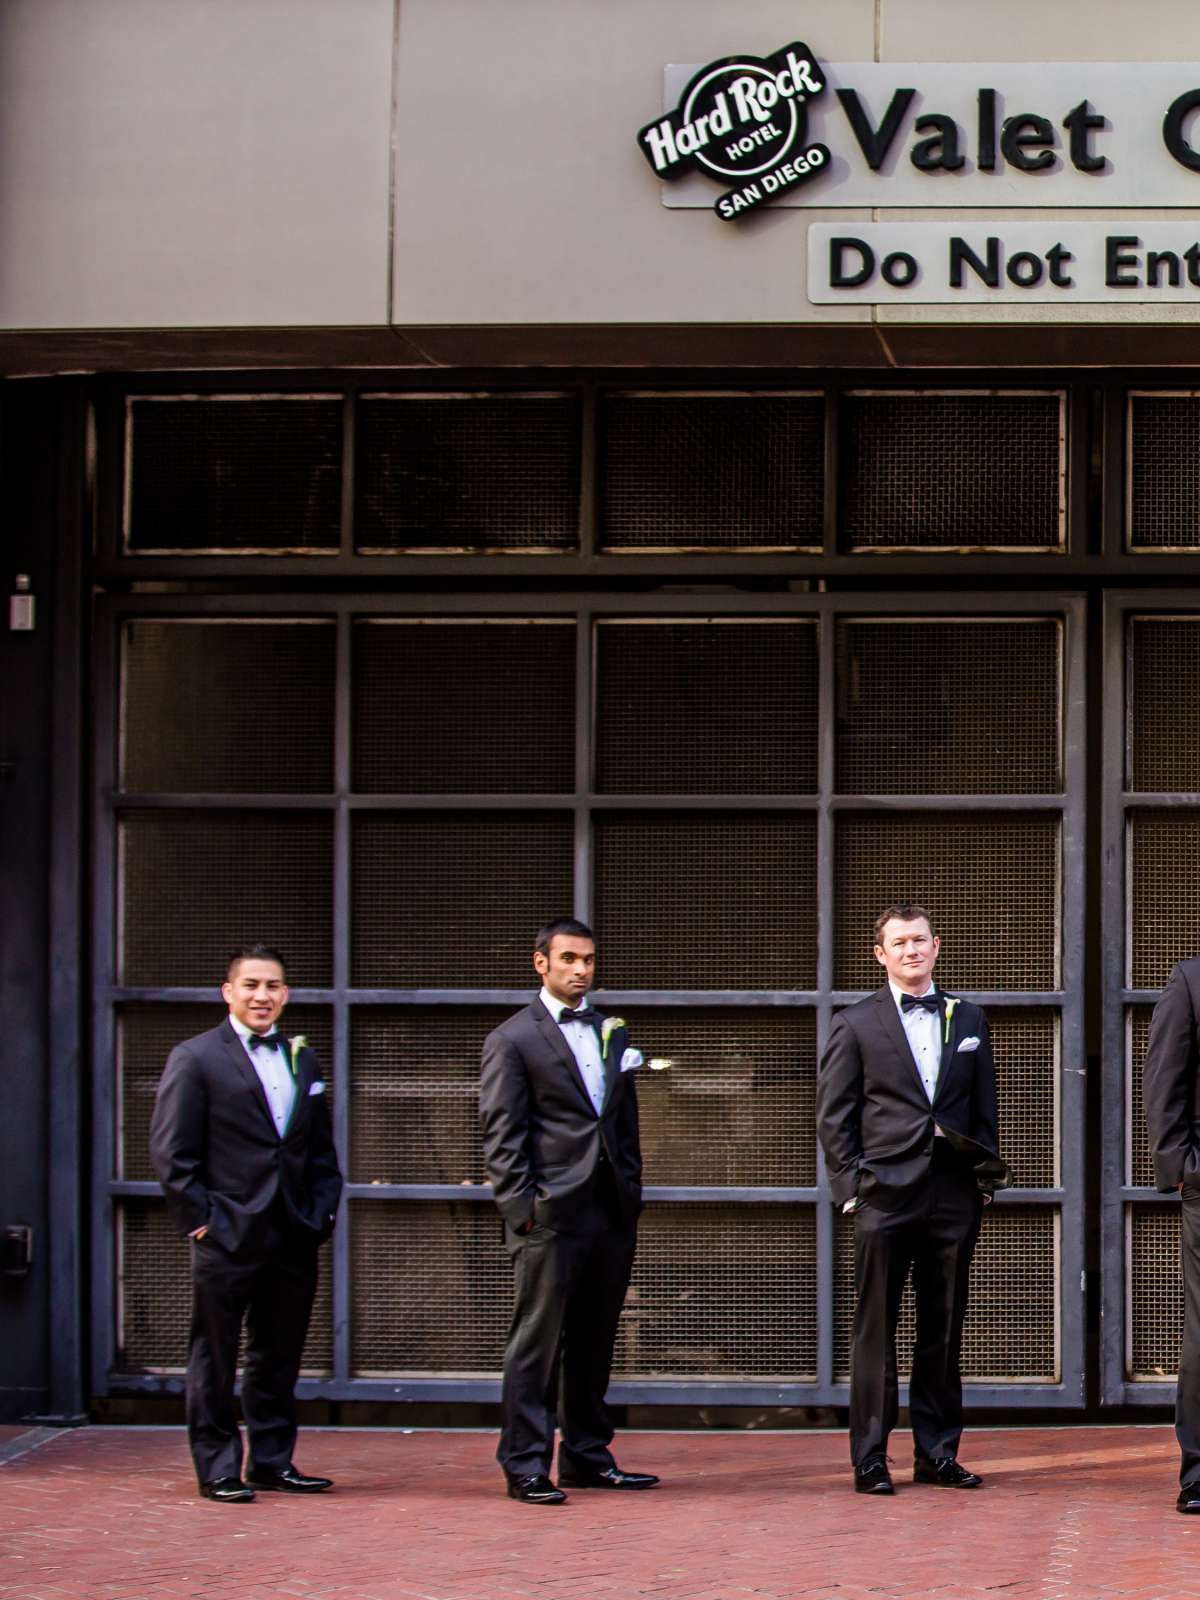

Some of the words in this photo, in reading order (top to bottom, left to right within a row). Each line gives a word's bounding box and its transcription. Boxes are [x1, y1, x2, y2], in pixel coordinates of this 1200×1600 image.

[645, 92, 734, 170] Hard
[728, 51, 823, 122] Rock
[725, 123, 783, 160] HOTEL
[834, 88, 1106, 173] Valet
[719, 184, 762, 218] SAN
[760, 148, 824, 193] DIEGO
[829, 237, 918, 290] Do
[949, 237, 1073, 290] Not
